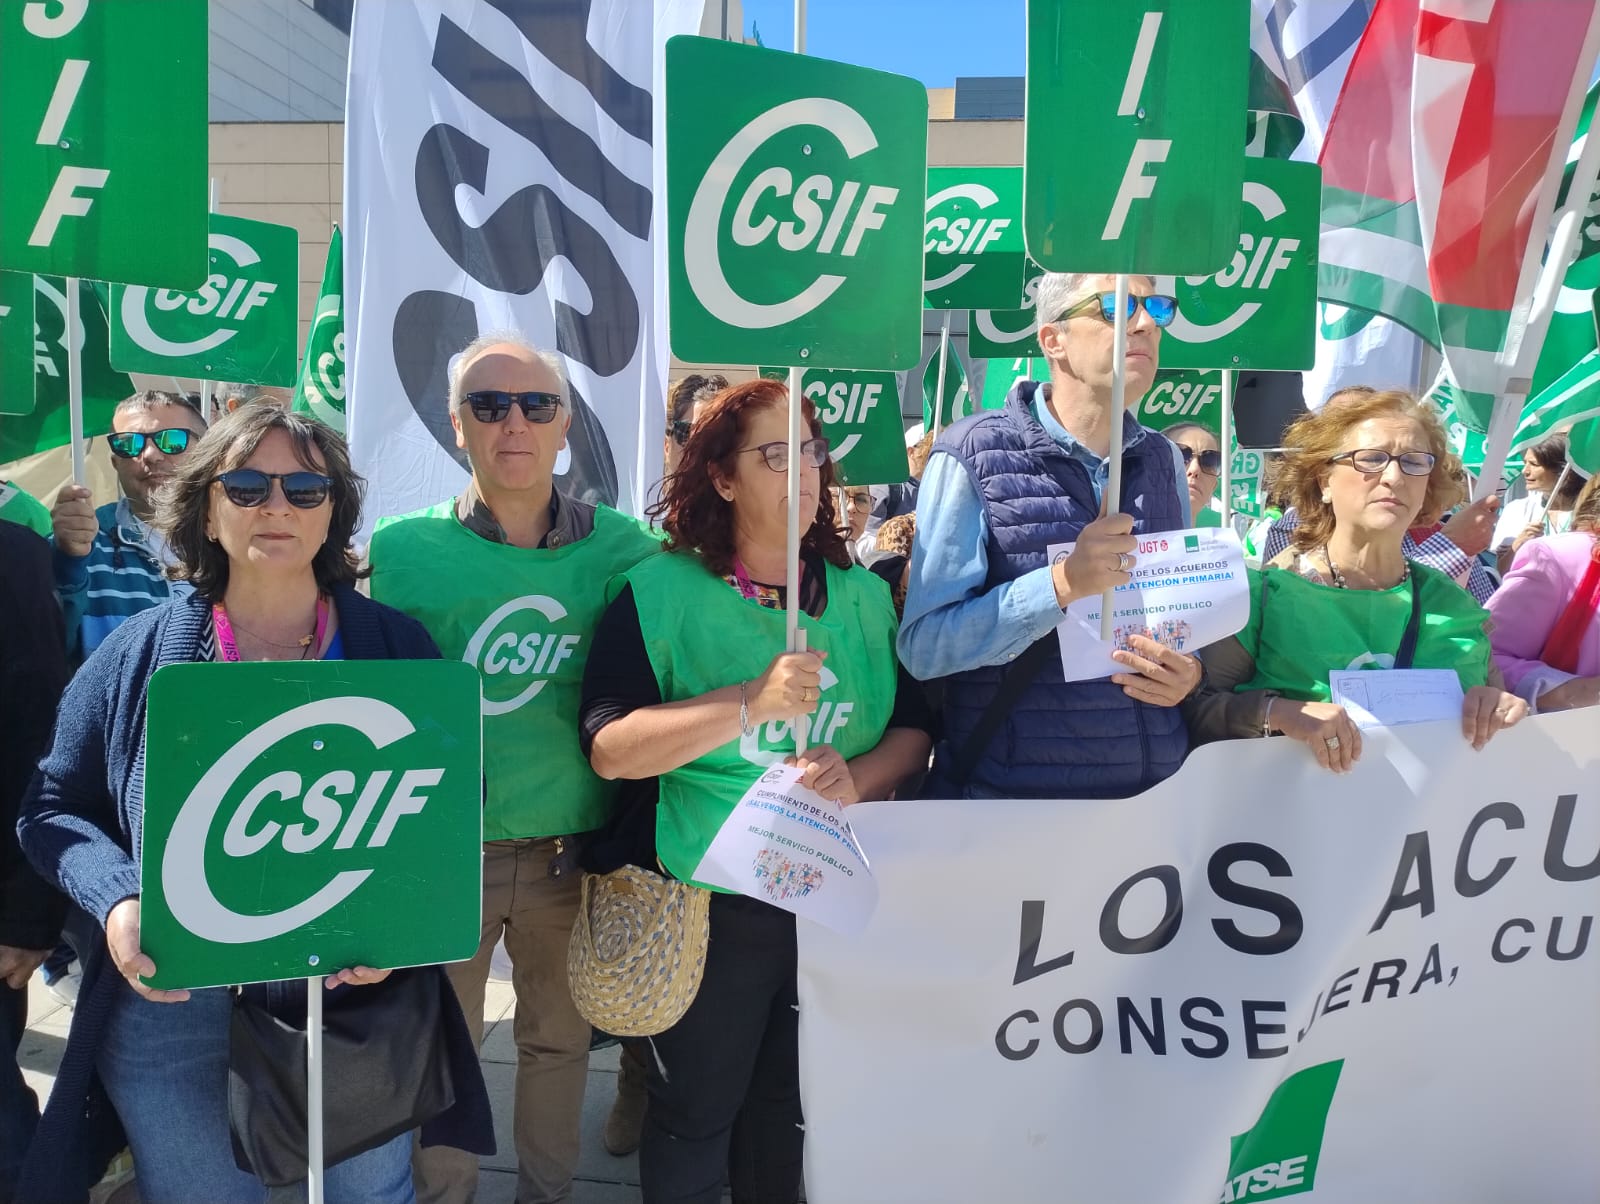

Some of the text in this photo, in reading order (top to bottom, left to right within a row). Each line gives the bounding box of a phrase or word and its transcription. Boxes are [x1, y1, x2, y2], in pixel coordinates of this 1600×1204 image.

[731, 165, 900, 257] CSIF
[924, 216, 1012, 255] CSIF
[1185, 233, 1301, 289] SIF
[1144, 381, 1222, 416] CSIF
[1138, 540, 1159, 554] UGT
[1114, 583, 1127, 592] LA
[1183, 571, 1234, 584] PRIMARIA!
[1136, 570, 1149, 578] DE
[1152, 567, 1171, 576] LOS
[1174, 560, 1229, 573] ACUERDOS
[1120, 604, 1166, 617] SERVICIO
[484, 631, 582, 675] CSIF
[222, 767, 447, 857] CSIF
[786, 809, 797, 820] LA
[810, 805, 822, 816] DE
[747, 824, 775, 841] MEJOR
[775, 833, 815, 855] SERVICIO
[1012, 841, 1304, 986] LOS
[994, 915, 1594, 1061] CONSEJERA, CU
